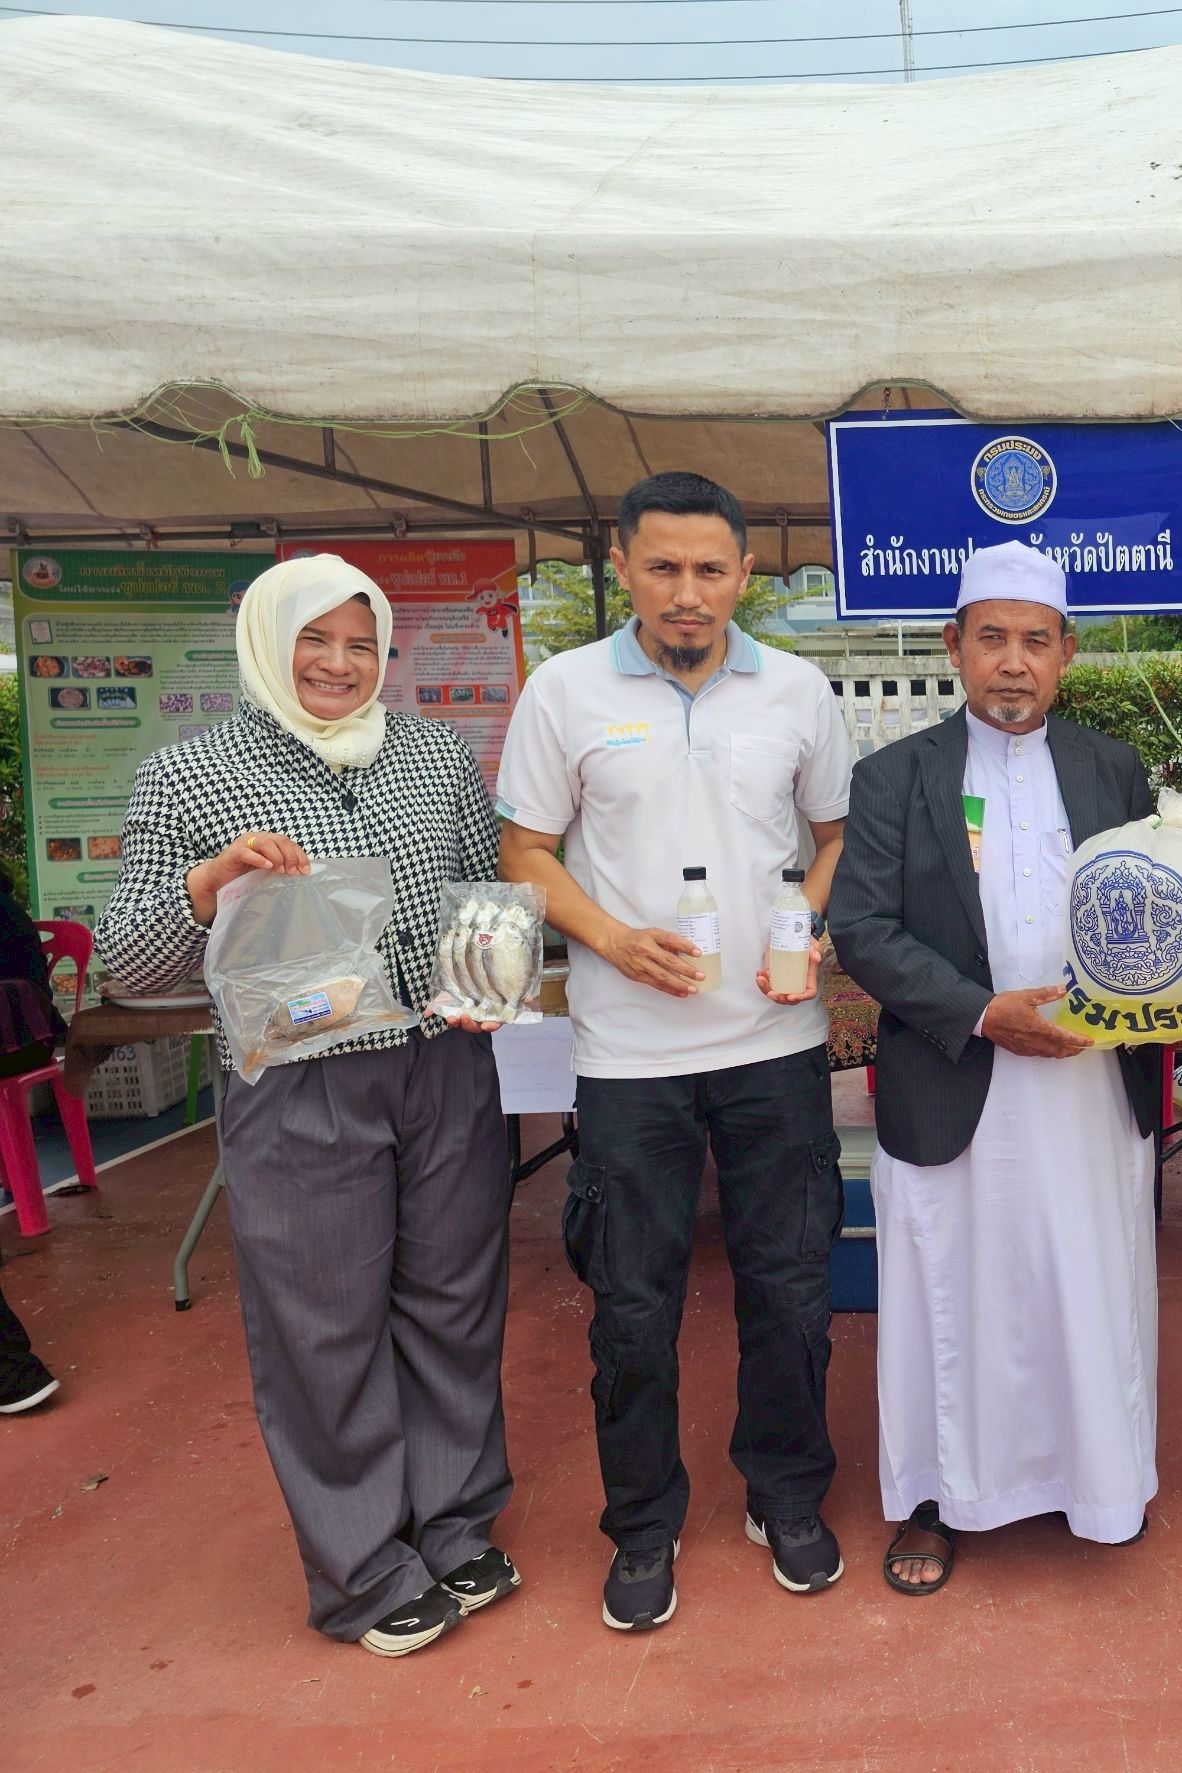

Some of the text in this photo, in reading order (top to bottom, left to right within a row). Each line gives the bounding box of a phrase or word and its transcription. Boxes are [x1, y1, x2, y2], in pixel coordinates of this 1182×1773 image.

[983, 440, 1042, 463] กรมประมง
[860, 529, 1174, 577] สำนักงานปัหวัดปัตตานี
